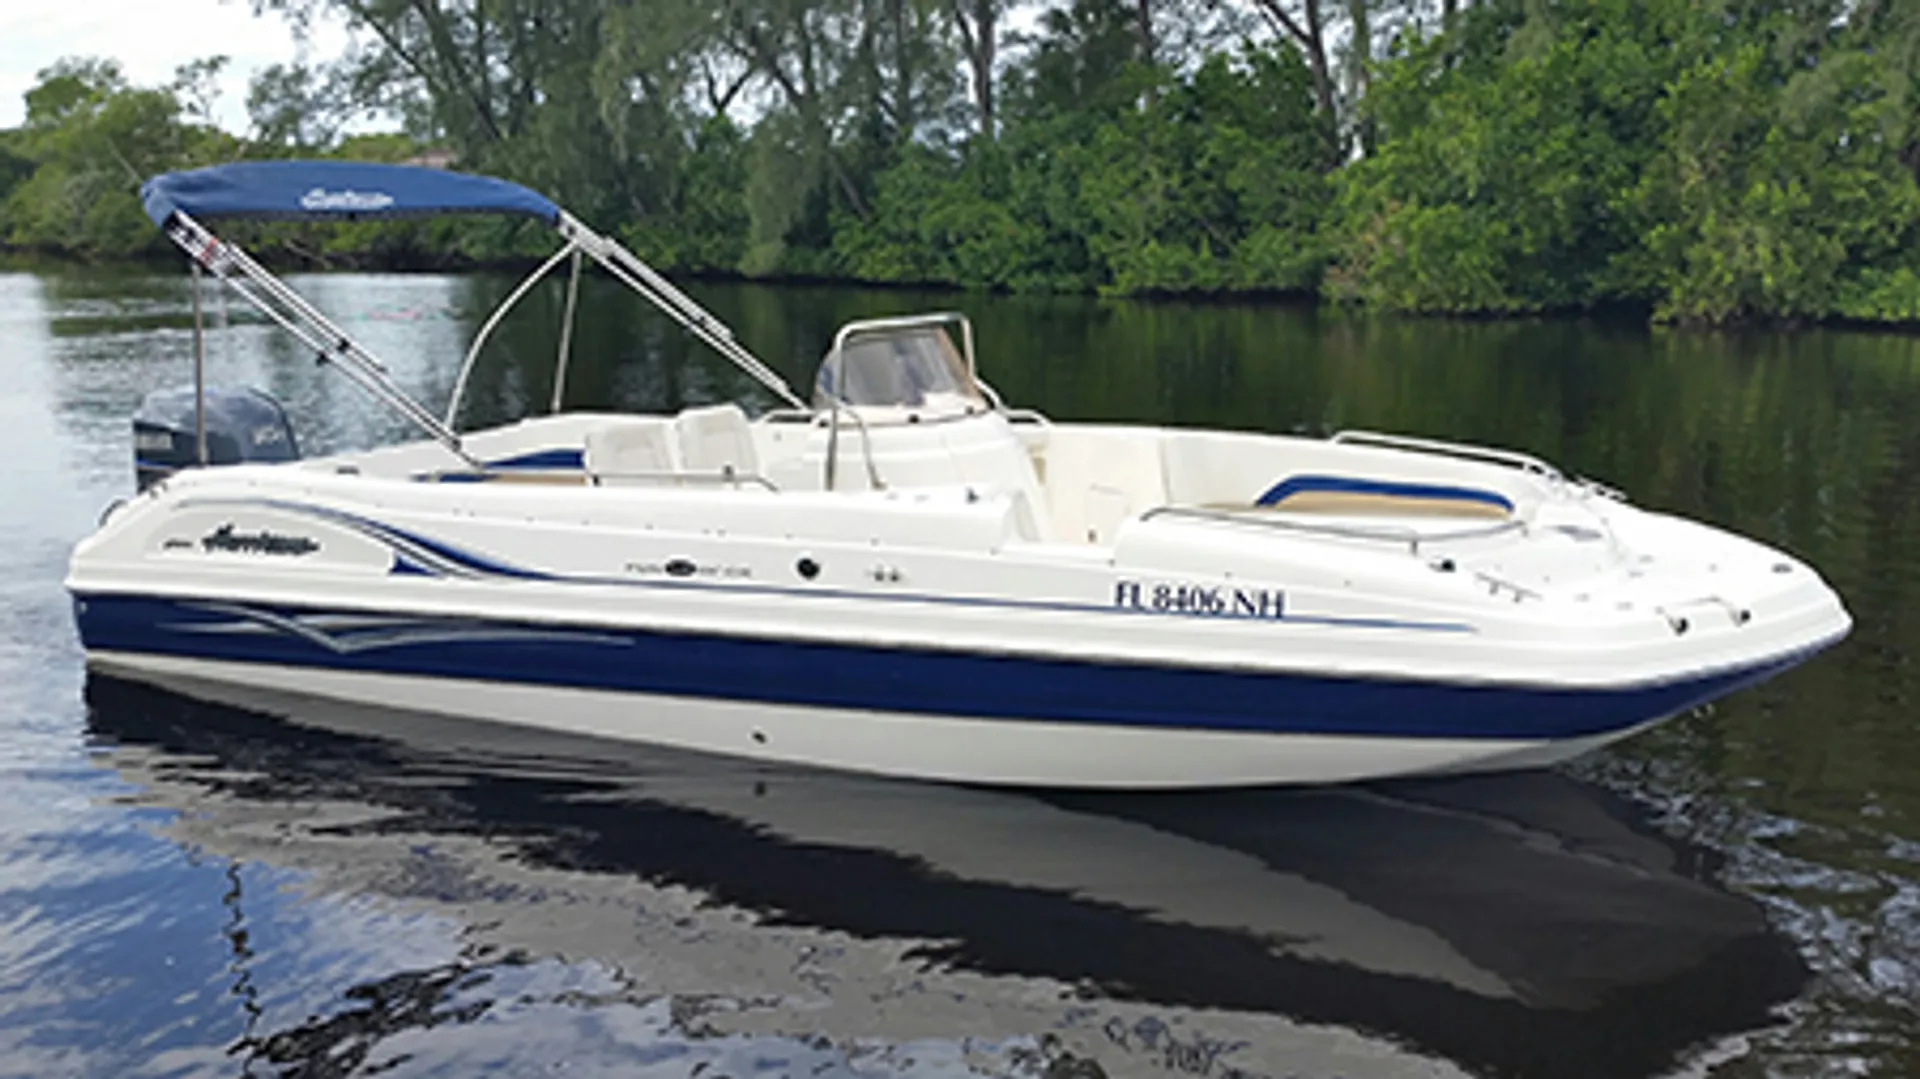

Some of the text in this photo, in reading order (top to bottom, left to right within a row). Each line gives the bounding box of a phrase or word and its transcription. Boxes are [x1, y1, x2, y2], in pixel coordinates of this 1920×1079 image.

[1115, 581, 1286, 619] FL 8406 NH
